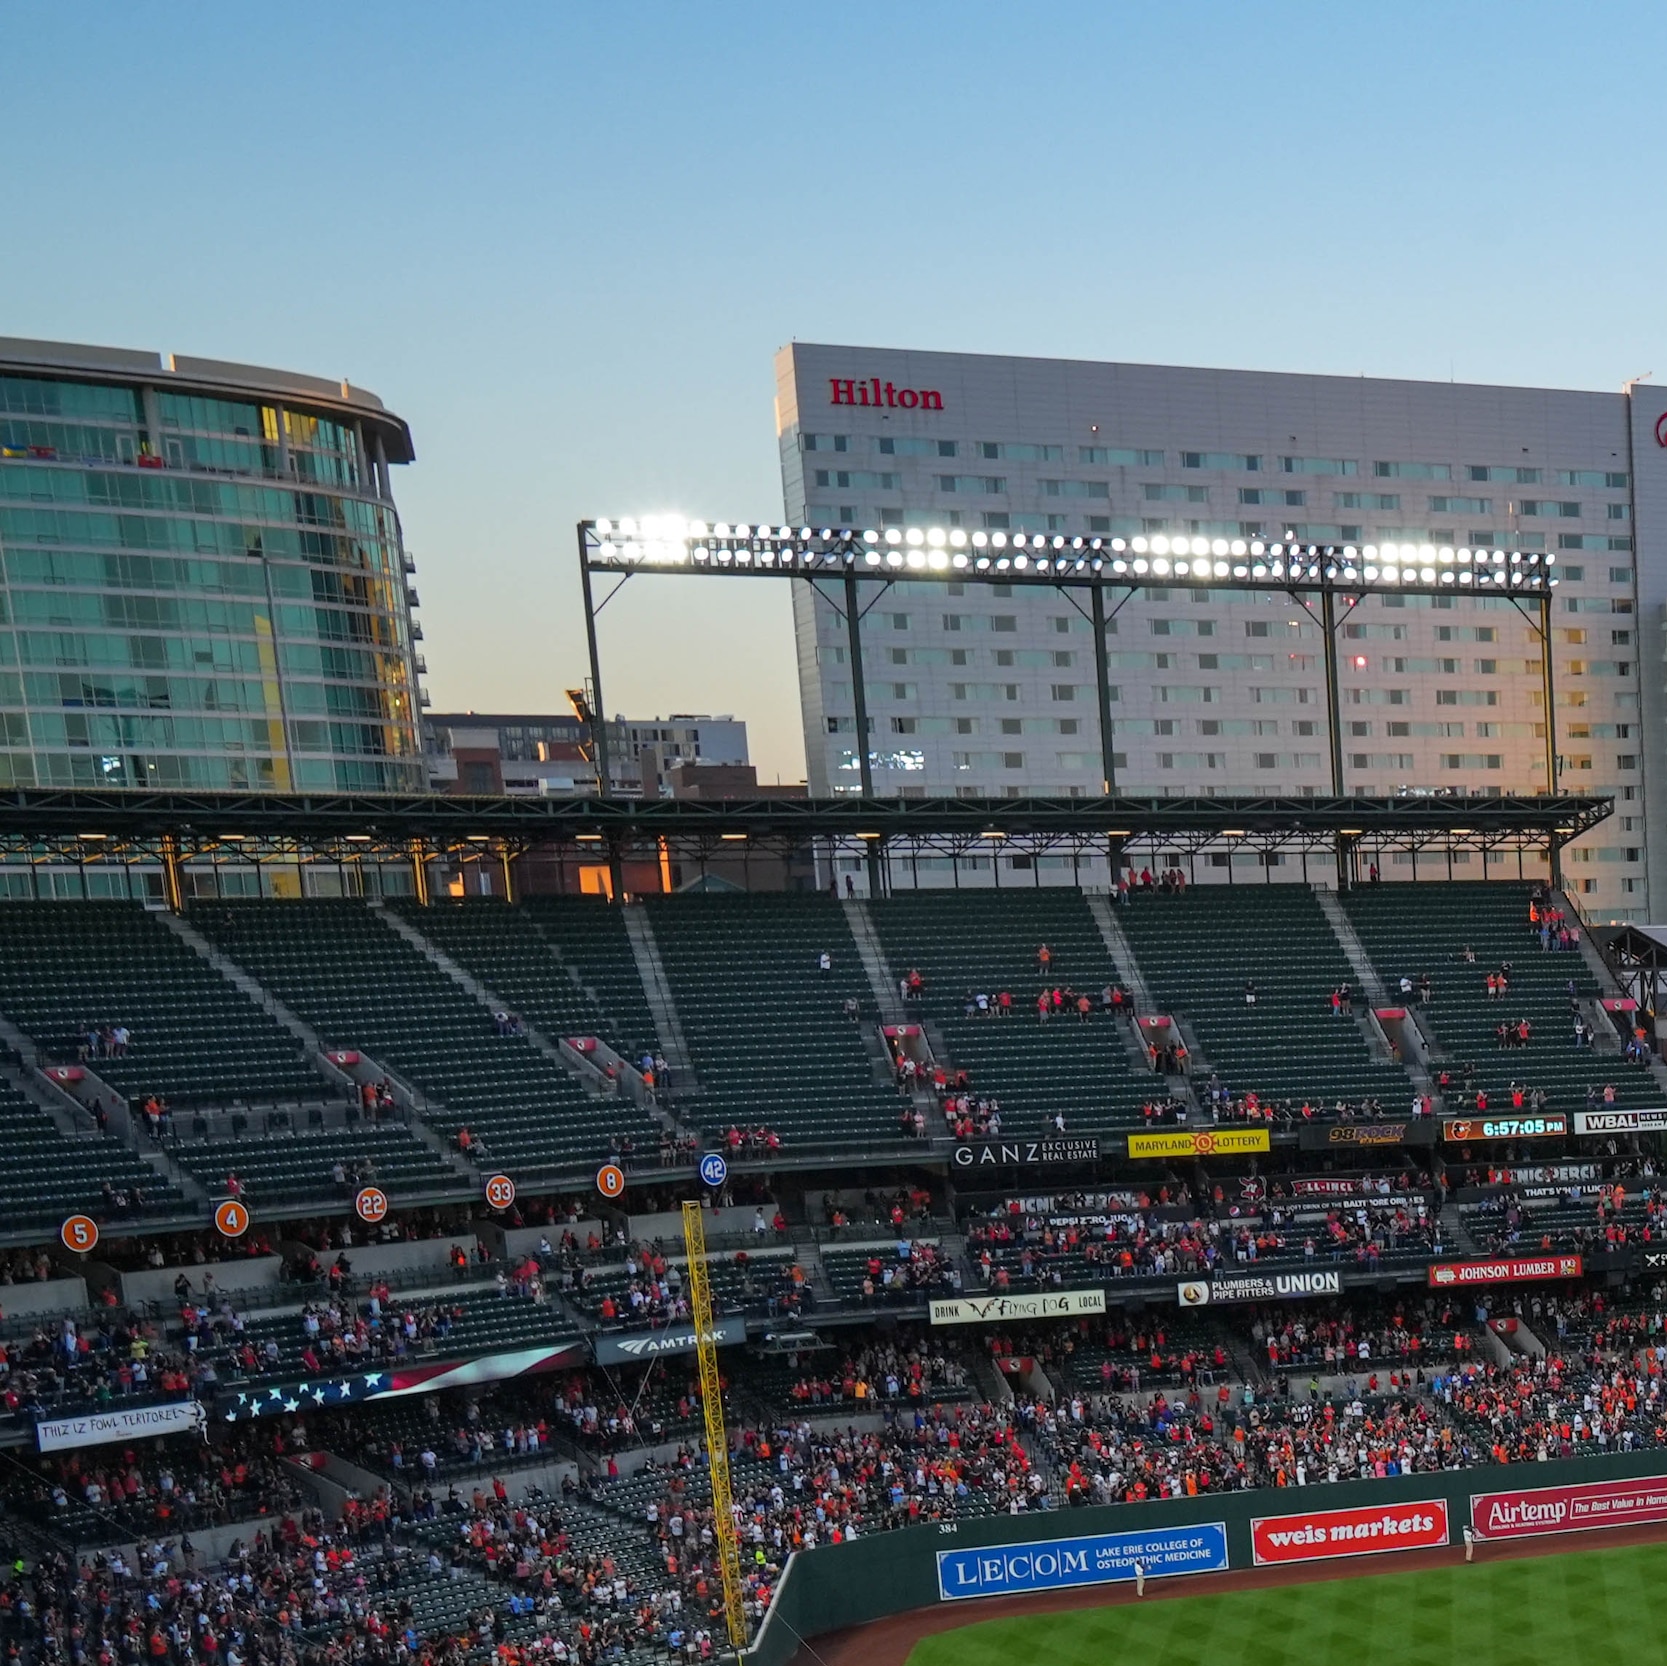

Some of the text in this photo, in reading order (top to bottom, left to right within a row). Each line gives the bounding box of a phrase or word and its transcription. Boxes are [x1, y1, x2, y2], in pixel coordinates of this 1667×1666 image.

[830, 378, 944, 410] Hilton
[1483, 1119, 1563, 1137] 6:57:05 PM
[1587, 1115, 1637, 1129] WBAL
[1042, 1140, 1097, 1151] EXCLUSIVE
[1135, 1140, 1191, 1151] MARYLAND
[1217, 1136, 1261, 1147] LOTTERY
[955, 1144, 1039, 1165] GANZ
[1042, 1149, 1097, 1161] REAL ESTATE
[704, 1161, 723, 1178] 42
[606, 1173, 616, 1189] 8
[491, 1183, 511, 1200] 33
[1525, 1188, 1555, 1197] THAT'S
[362, 1195, 385, 1215] 22
[226, 1209, 238, 1228] 4
[1050, 1217, 1078, 1226] PEPSI
[74, 1223, 87, 1243] 5
[1459, 1265, 1509, 1280] JOHNSON
[1513, 1262, 1555, 1276] LUMBER
[1212, 1279, 1272, 1292] PLUMBERS &
[1276, 1272, 1339, 1294] UNION
[1212, 1289, 1235, 1300] PIPE
[1237, 1287, 1274, 1298] FITTERS
[935, 1306, 960, 1318] DRINK
[1078, 1294, 1102, 1308] LOCAL
[42, 1424, 69, 1438] THIZ
[90, 1418, 120, 1433] FOWL
[1489, 1500, 1566, 1524] Airtemp
[1575, 1503, 1588, 1513] The
[1591, 1501, 1609, 1512] Best
[1612, 1499, 1634, 1509] Value
[938, 1522, 958, 1535] 384
[1267, 1513, 1434, 1547] weis markets
[1096, 1538, 1204, 1558] LAKE ERIE COLLEGE OF
[1164, 1549, 1212, 1564] MEDICINE
